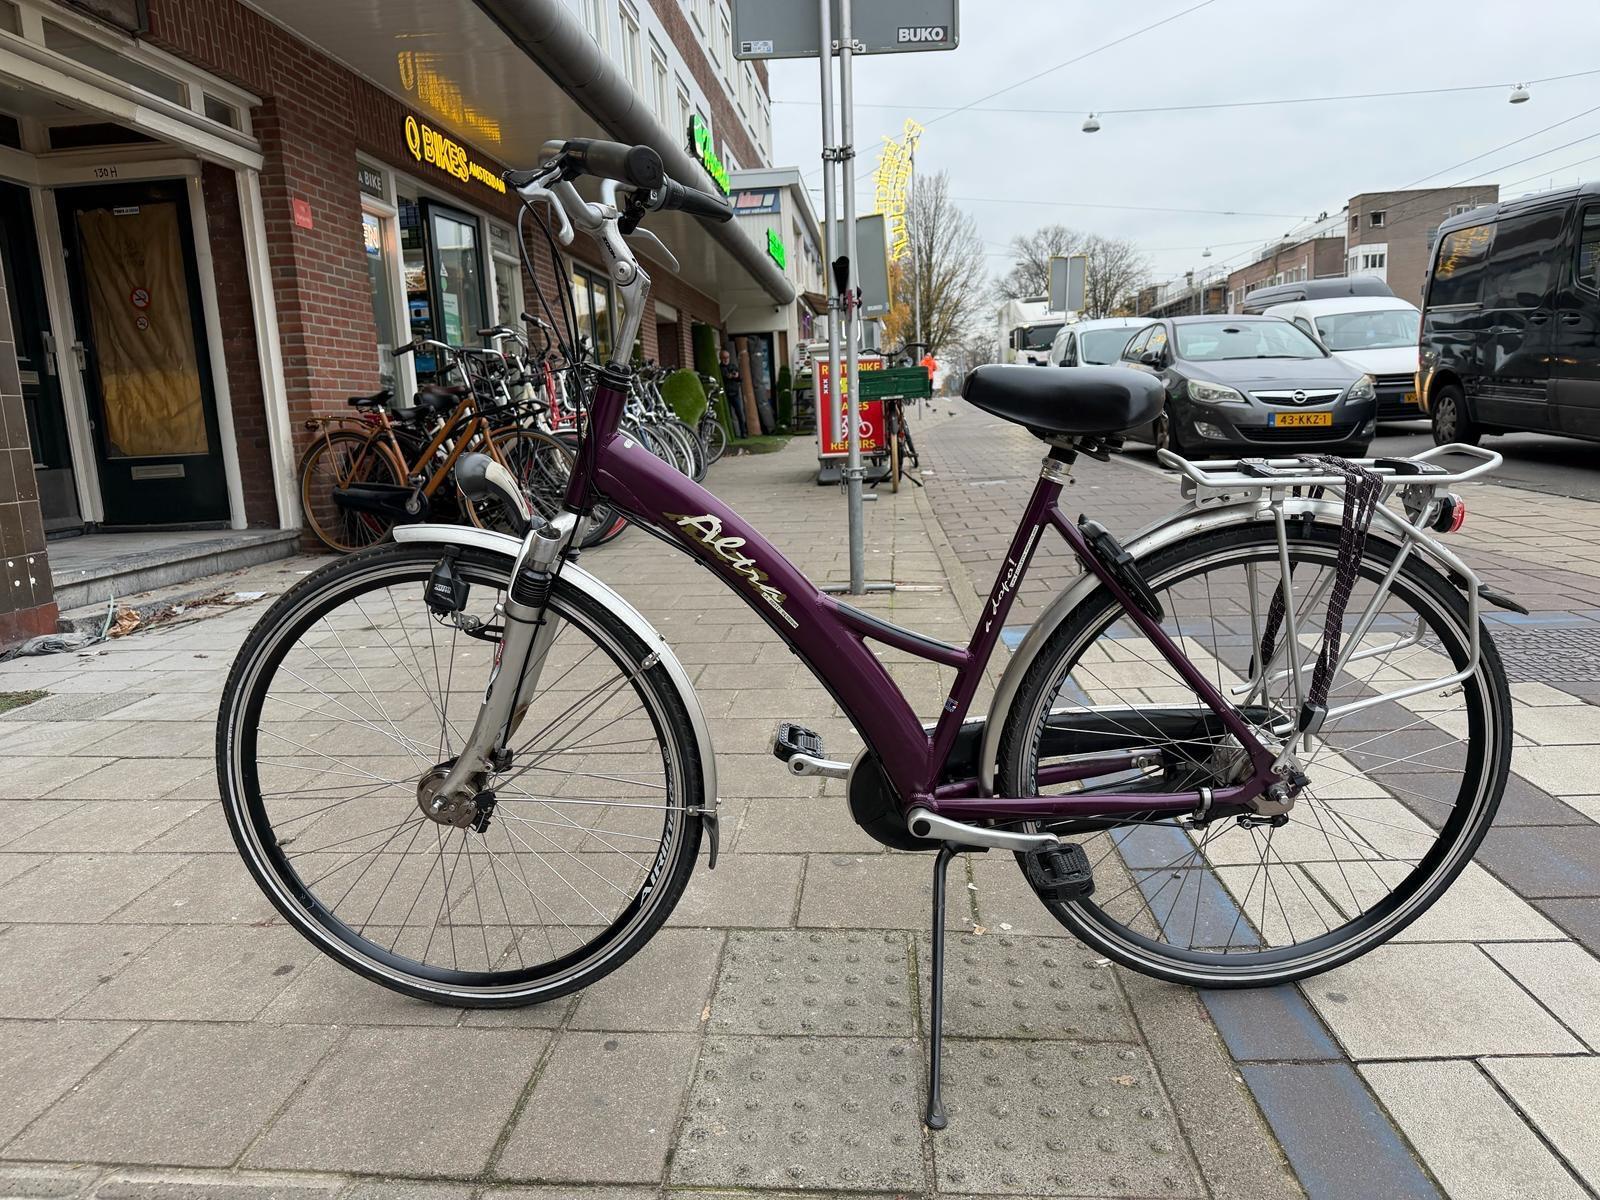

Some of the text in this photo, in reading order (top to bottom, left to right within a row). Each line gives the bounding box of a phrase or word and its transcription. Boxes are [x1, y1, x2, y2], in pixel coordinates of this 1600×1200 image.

[405, 116, 506, 194] Q BIKES AMSTERDAM
[94, 165, 118, 178] 130 H
[363, 170, 382, 191] BIKE
[362, 222, 379, 247] EN
[821, 363, 848, 375] RT
[1280, 415, 1327, 425] 43-KKZ-1
[830, 439, 877, 450] REPIRS
[677, 513, 782, 604] Altra
